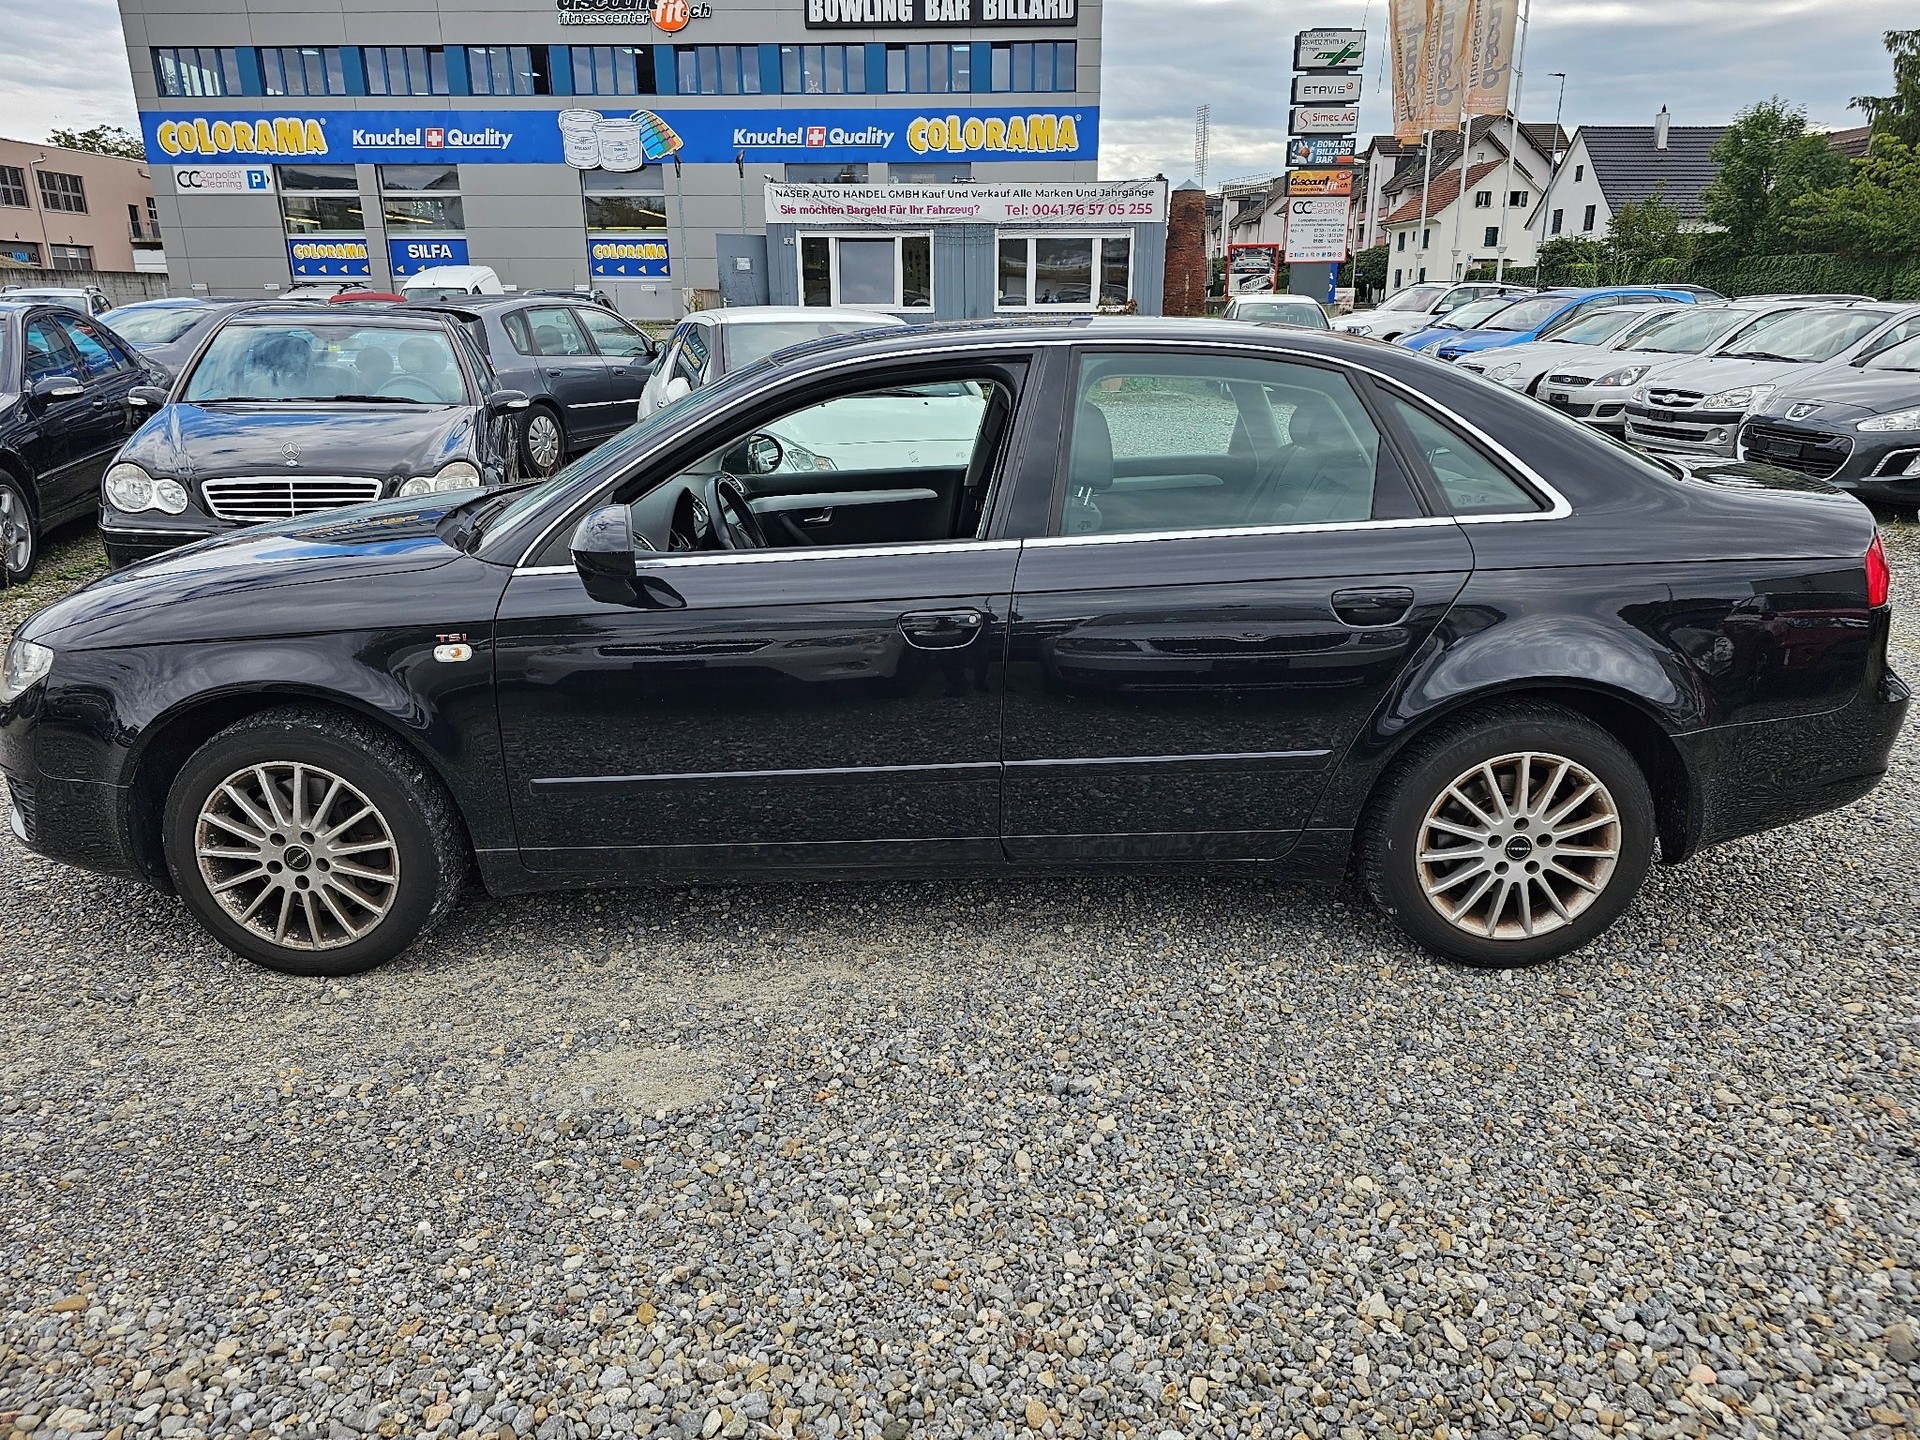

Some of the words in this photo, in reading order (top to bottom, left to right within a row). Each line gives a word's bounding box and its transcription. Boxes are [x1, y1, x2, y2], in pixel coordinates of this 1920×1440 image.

[808, 0, 913, 23] BOWLING
[925, 0, 970, 22] BAR
[982, 0, 1074, 20] BILLARD
[558, 12, 650, 24] fitnesscenter
[1303, 85, 1346, 95] ETAVIS
[1312, 112, 1339, 122] Simec
[1341, 112, 1356, 122] AG
[157, 117, 328, 157] COLORAMA
[352, 128, 421, 146] Knuchel
[447, 128, 514, 150] Quality
[733, 126, 803, 145] Knuchel
[829, 126, 895, 149] Quality
[907, 114, 1079, 154] COLORAMA
[1316, 140, 1355, 148] BOWLING
[1315, 147, 1352, 156] BILLARD
[1315, 155, 1334, 164] BAR
[200, 170, 241, 180] Carpolish
[251, 172, 261, 187] P
[200, 179, 243, 190] Cleaning
[775, 190, 810, 199] NASER
[812, 190, 840, 199] AUTO
[843, 190, 886, 199] HANDEL
[888, 190, 919, 199] GMBH
[921, 189, 945, 199] Kauf
[947, 189, 968, 199] Und
[970, 188, 1012, 199] Verkauf
[1012, 188, 1032, 198] Alle
[1035, 188, 1073, 198] Marken
[1076, 188, 1098, 198] Und
[1099, 188, 1155, 200] Jahrgänge
[780, 204, 797, 215] Sie
[799, 203, 845, 215] möchten
[846, 204, 887, 217] Bargeld
[889, 203, 907, 215] Für
[909, 204, 924, 215] Ihr
[926, 204, 981, 217] Fahrzeug?
[1005, 204, 1029, 216] Tel:
[1032, 204, 1064, 216] 0041
[1067, 204, 1085, 216] 76
[1088, 204, 1105, 216] 57
[1108, 203, 1125, 215] 05
[1128, 203, 1153, 215] 255
[15, 231, 20, 240] 4
[69, 235, 74, 244] 3
[294, 243, 368, 259] COLORAMA
[407, 244, 453, 259] SILFA
[593, 243, 667, 260] COLORAMA
